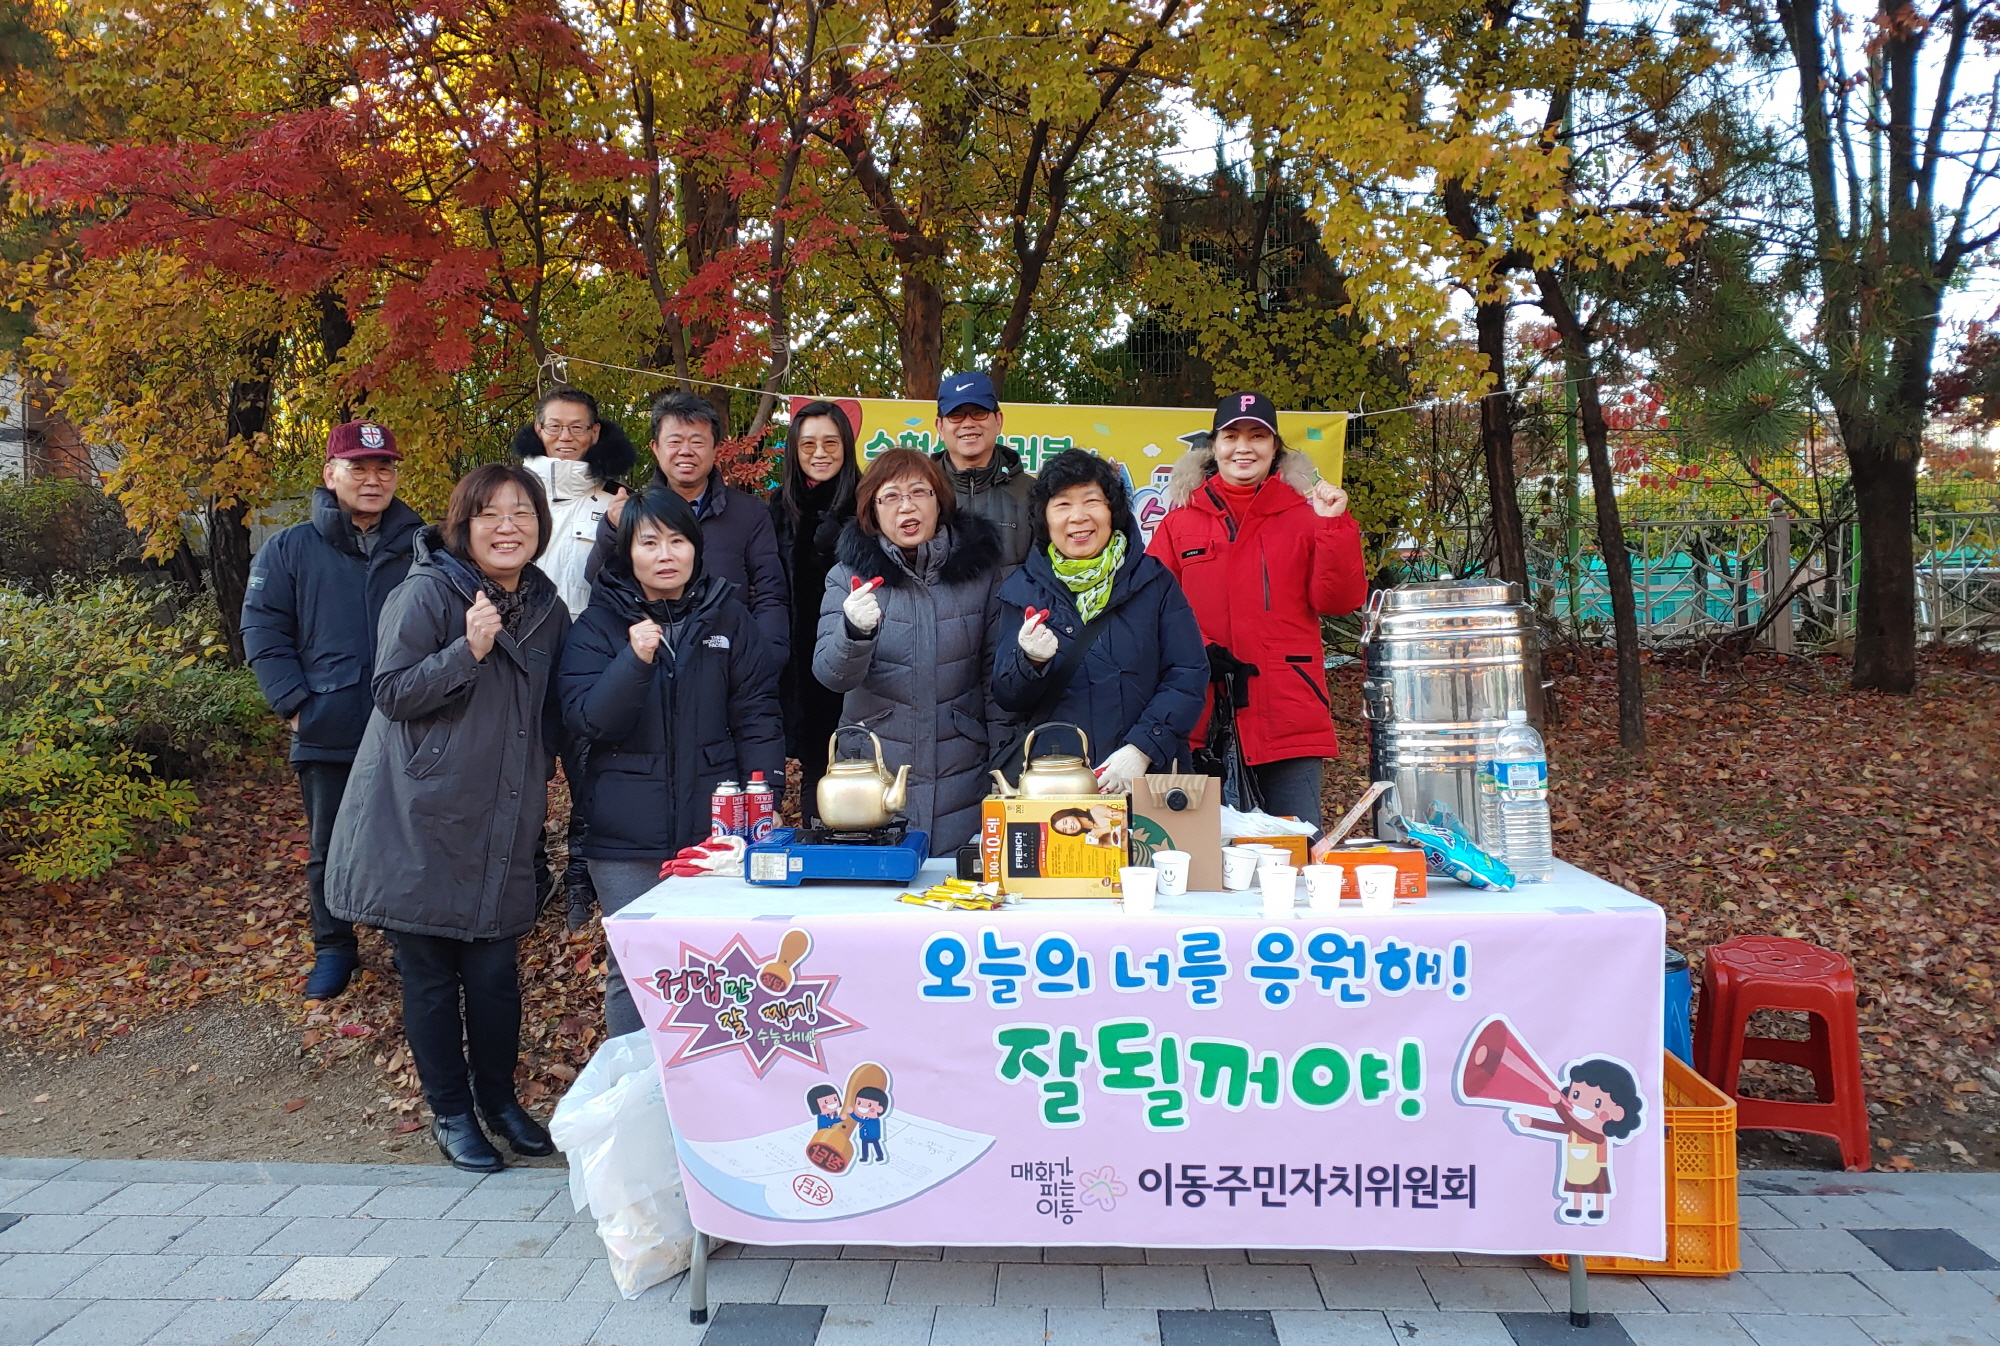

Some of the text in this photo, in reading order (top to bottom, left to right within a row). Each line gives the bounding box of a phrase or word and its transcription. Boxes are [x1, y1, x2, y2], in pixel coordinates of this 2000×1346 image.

[1240, 395, 1255, 412] P
[1015, 831, 1023, 869] FRENCH
[922, 931, 1467, 1005] 오늘의 너를 응원해!
[719, 994, 816, 1039] 잘 찍어!
[1011, 1156, 1073, 1181] 매화가
[1040, 1179, 1076, 1197] 피는
[1138, 1162, 1476, 1209] 이동주민자치위원회
[1036, 1199, 1083, 1225] 이동
